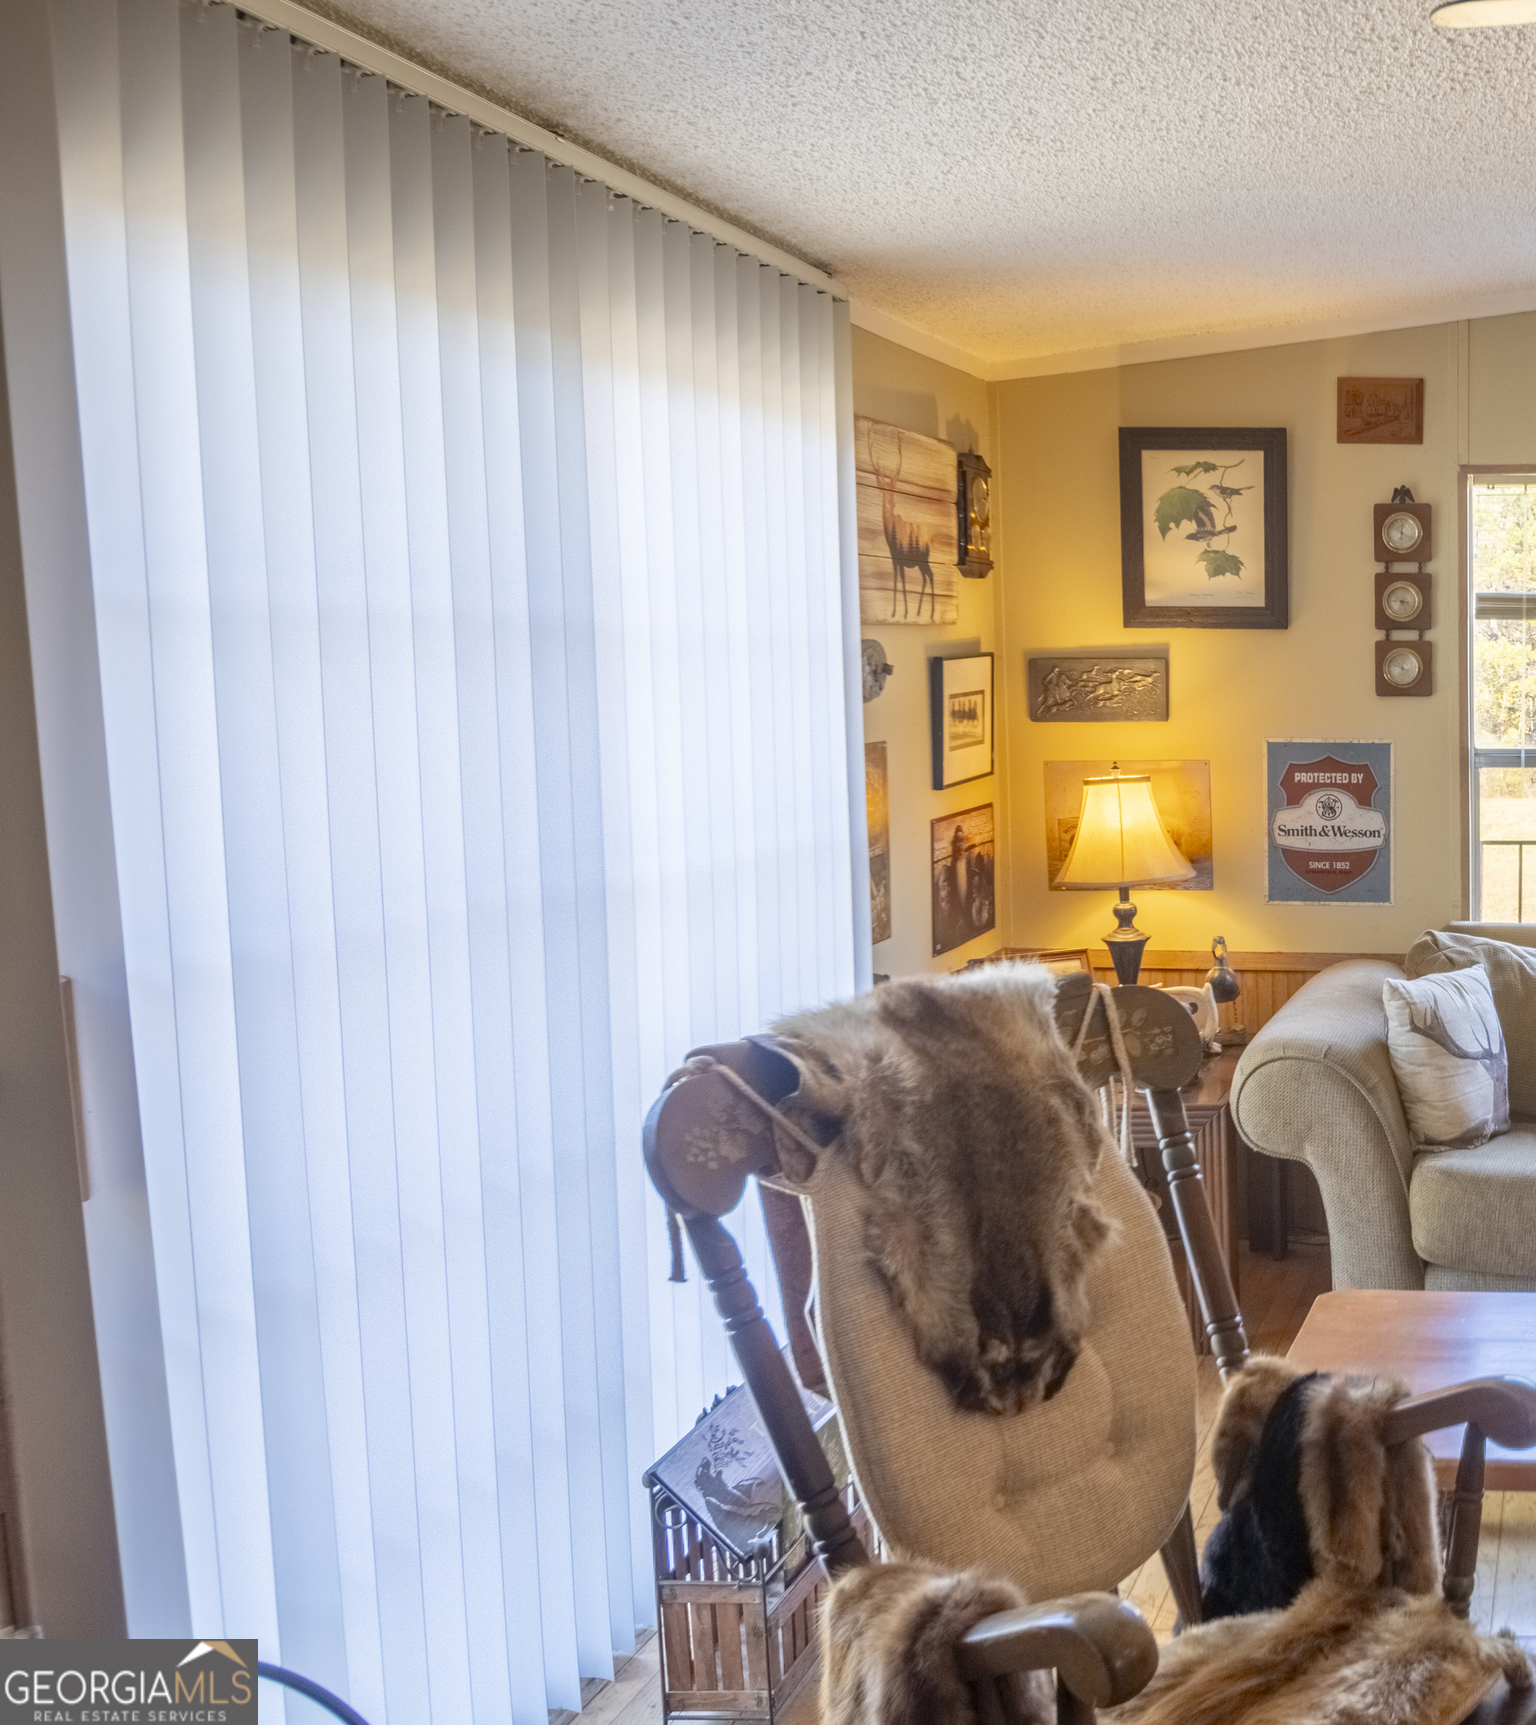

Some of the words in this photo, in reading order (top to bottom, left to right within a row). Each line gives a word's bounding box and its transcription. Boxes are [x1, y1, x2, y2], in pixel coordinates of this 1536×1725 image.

[1294, 772, 1349, 784] PROTECTED
[1351, 773, 1364, 784] BY
[1308, 861, 1330, 869] SINCE
[1332, 861, 1350, 869] 1852
